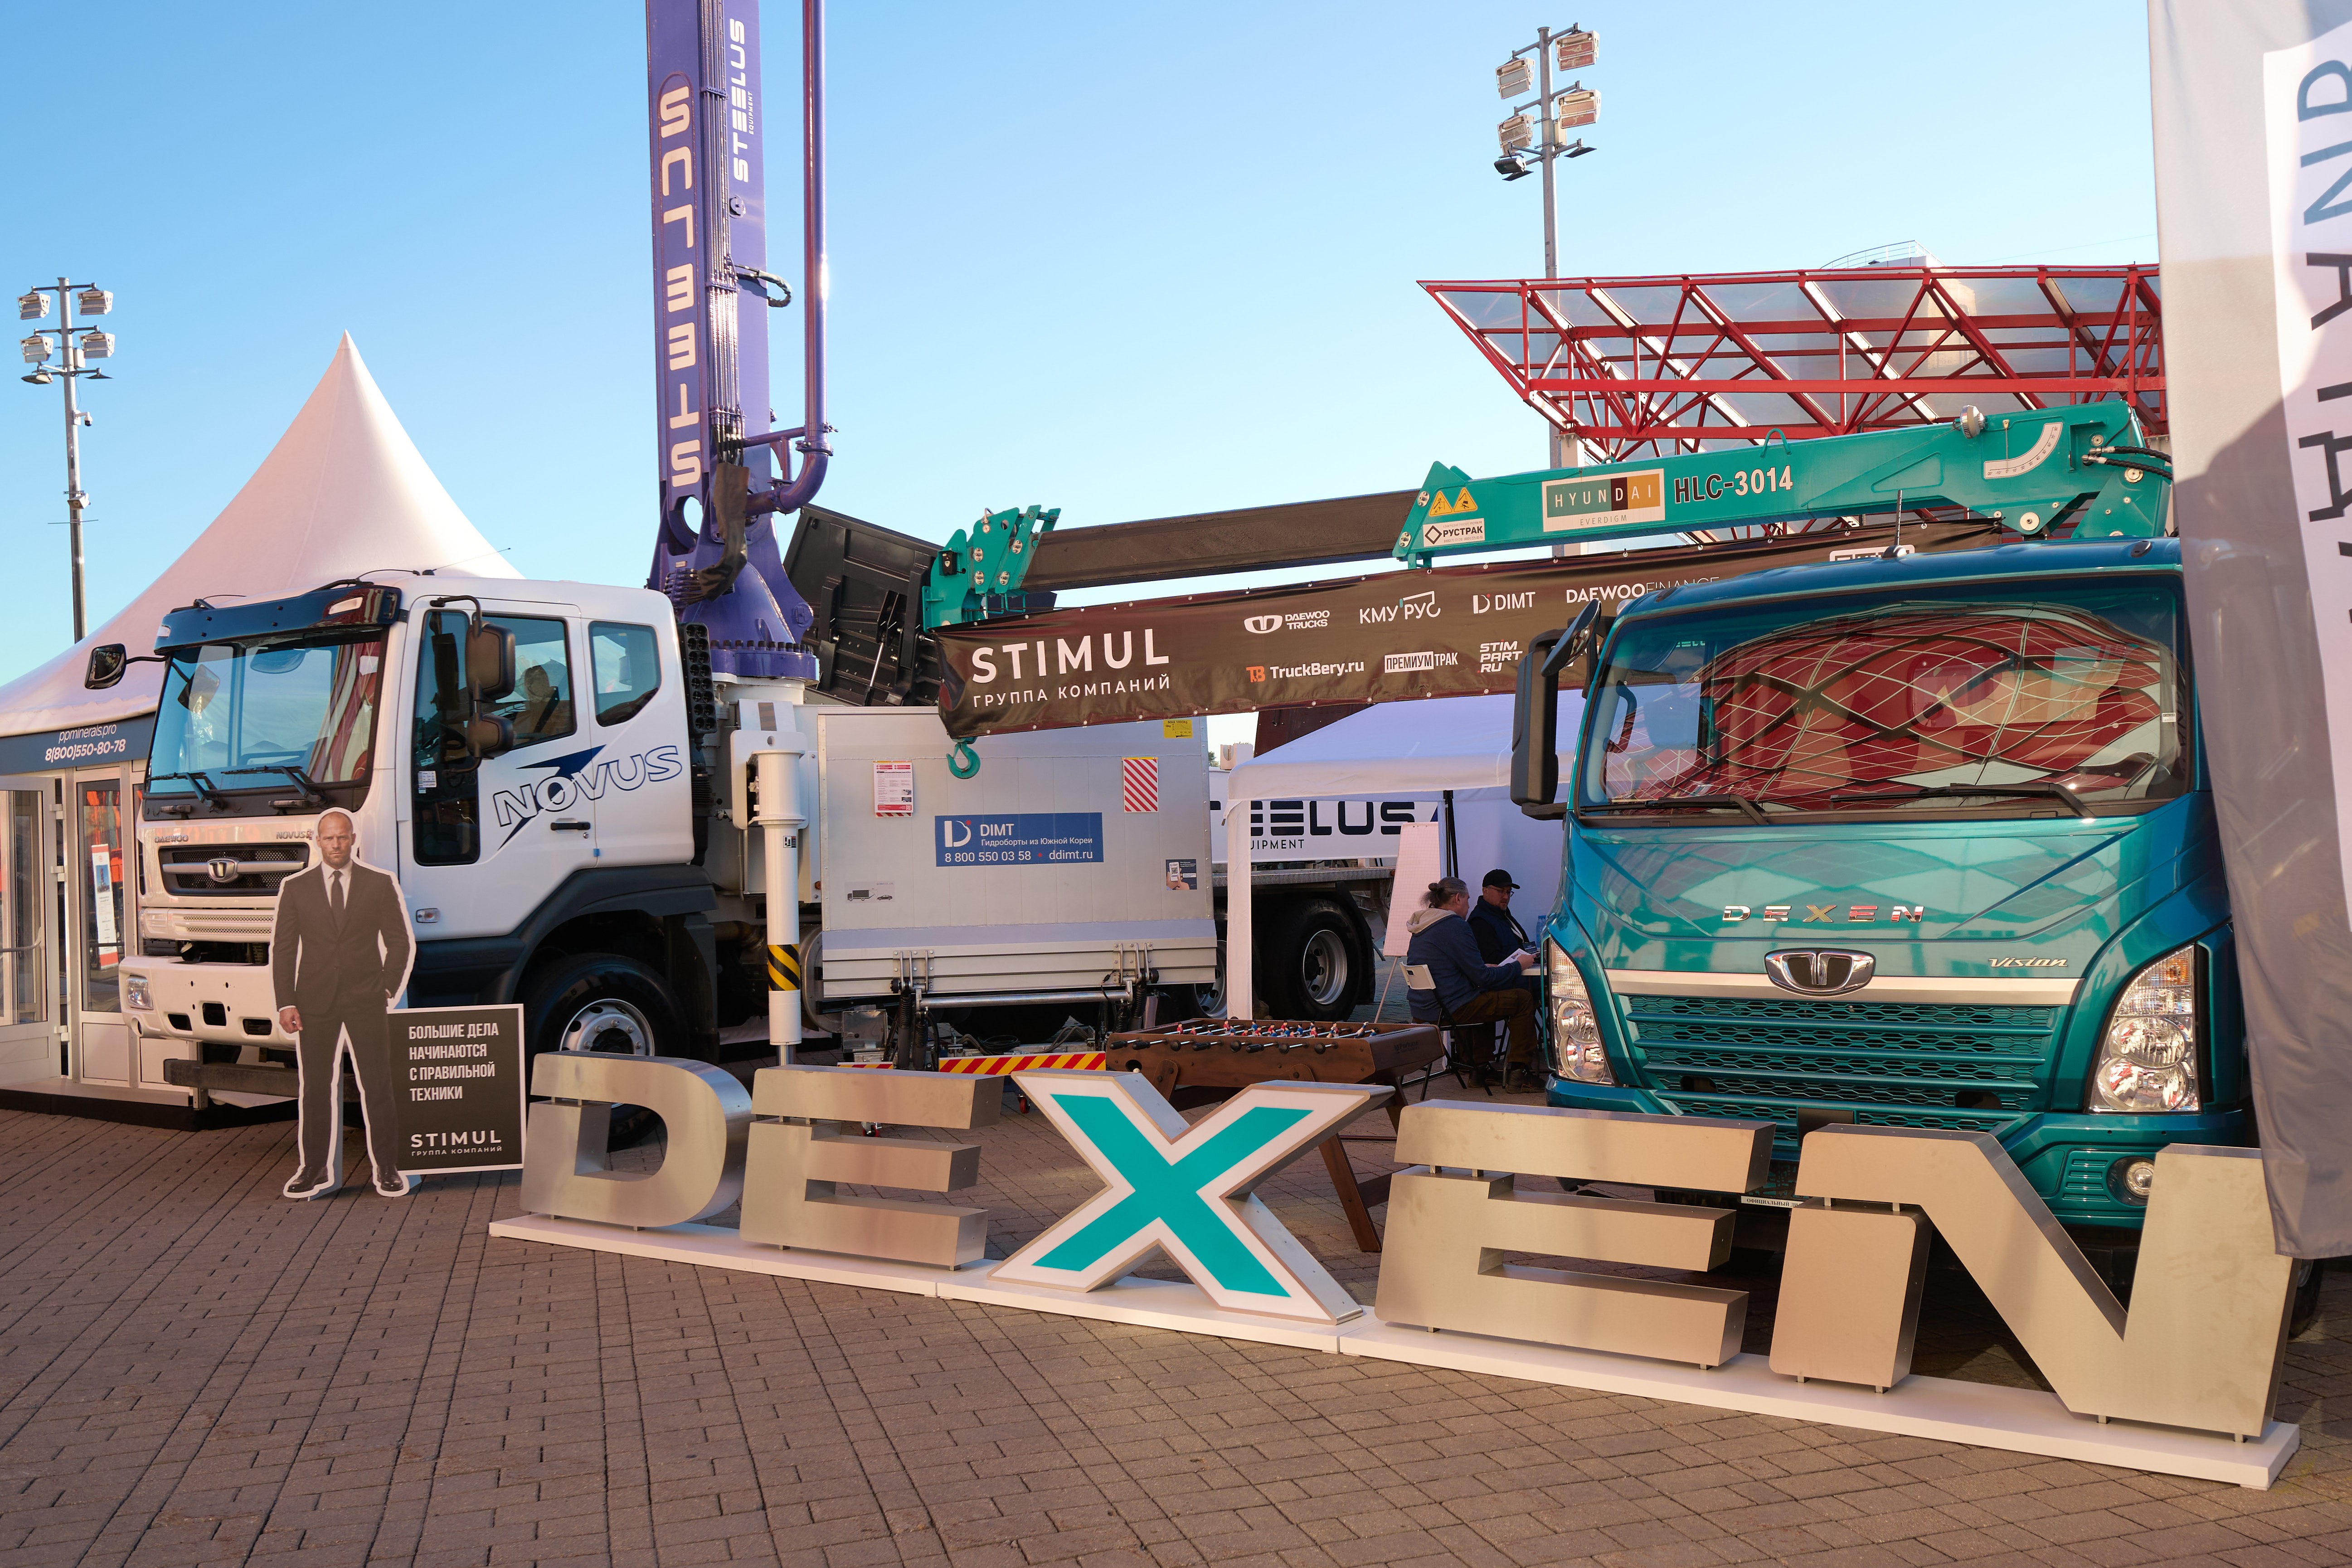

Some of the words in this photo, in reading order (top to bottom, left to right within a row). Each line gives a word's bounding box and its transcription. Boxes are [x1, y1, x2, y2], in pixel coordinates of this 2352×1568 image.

[729, 18, 748, 183] STEELUS
[660, 86, 701, 488] STEELUS
[1674, 465, 1793, 504] HLC-3014
[1555, 485, 1651, 508] HYUNDAI
[1580, 515, 1627, 526] EVERDIGM
[1443, 526, 1483, 537] РУСТРАК
[1495, 592, 1536, 611] DIMT
[1285, 610, 1330, 621] DAEWOO
[1360, 605, 1399, 624] КМУ
[1404, 597, 1441, 620] РУС
[1287, 619, 1328, 630] TRUCKS
[1480, 640, 1518, 653] STIM
[972, 628, 1169, 684] STIMUL
[1386, 654, 1432, 670] ПРЕМИУМ
[1434, 652, 1458, 666] ТРАК
[1480, 651, 1523, 663] PART
[1270, 661, 1365, 679] TruckBery.ru
[973, 689, 1048, 708] ГРУППА
[1058, 674, 1170, 699] КОМПАНИЙ
[58, 724, 117, 744] ppminerals.pro
[45, 738, 126, 763] 8(800)550-80-78
[493, 745, 682, 827] NOVUS
[276, 831, 306, 839] NOVUS
[980, 823, 1014, 836] DIMT
[155, 835, 189, 843] DAEWOO
[981, 839, 1028, 847] Гидроборты
[1041, 837, 1068, 845] Южной
[1069, 837, 1093, 845] Кореи
[945, 853, 952, 862] 8
[955, 852, 975, 862] 800
[978, 852, 998, 861] 550
[1001, 851, 1015, 861] 03
[1018, 850, 1031, 860] 58
[1049, 850, 1093, 860] ddimt.ru
[1722, 905, 1925, 922] DEXEN
[1988, 956, 2068, 967] Vision
[408, 1024, 465, 1039] БОЛЬШИЕ
[467, 1023, 499, 1039] ДЕЛА
[409, 1044, 487, 1060] НАЧИНАЮТСЯ
[410, 1067, 417, 1081] С
[420, 1061, 496, 1080] ПРАВИЛЬНОЙ
[410, 1086, 463, 1101] ТЕХНИКИ
[411, 1130, 502, 1148] STIMUL
[451, 1146, 502, 1155] КОМПАНИЙ
[1747, 1198, 1789, 1207] ОФИЦИАЛЬНЫЙ
[520, 1050, 2289, 1438] DEXEN
